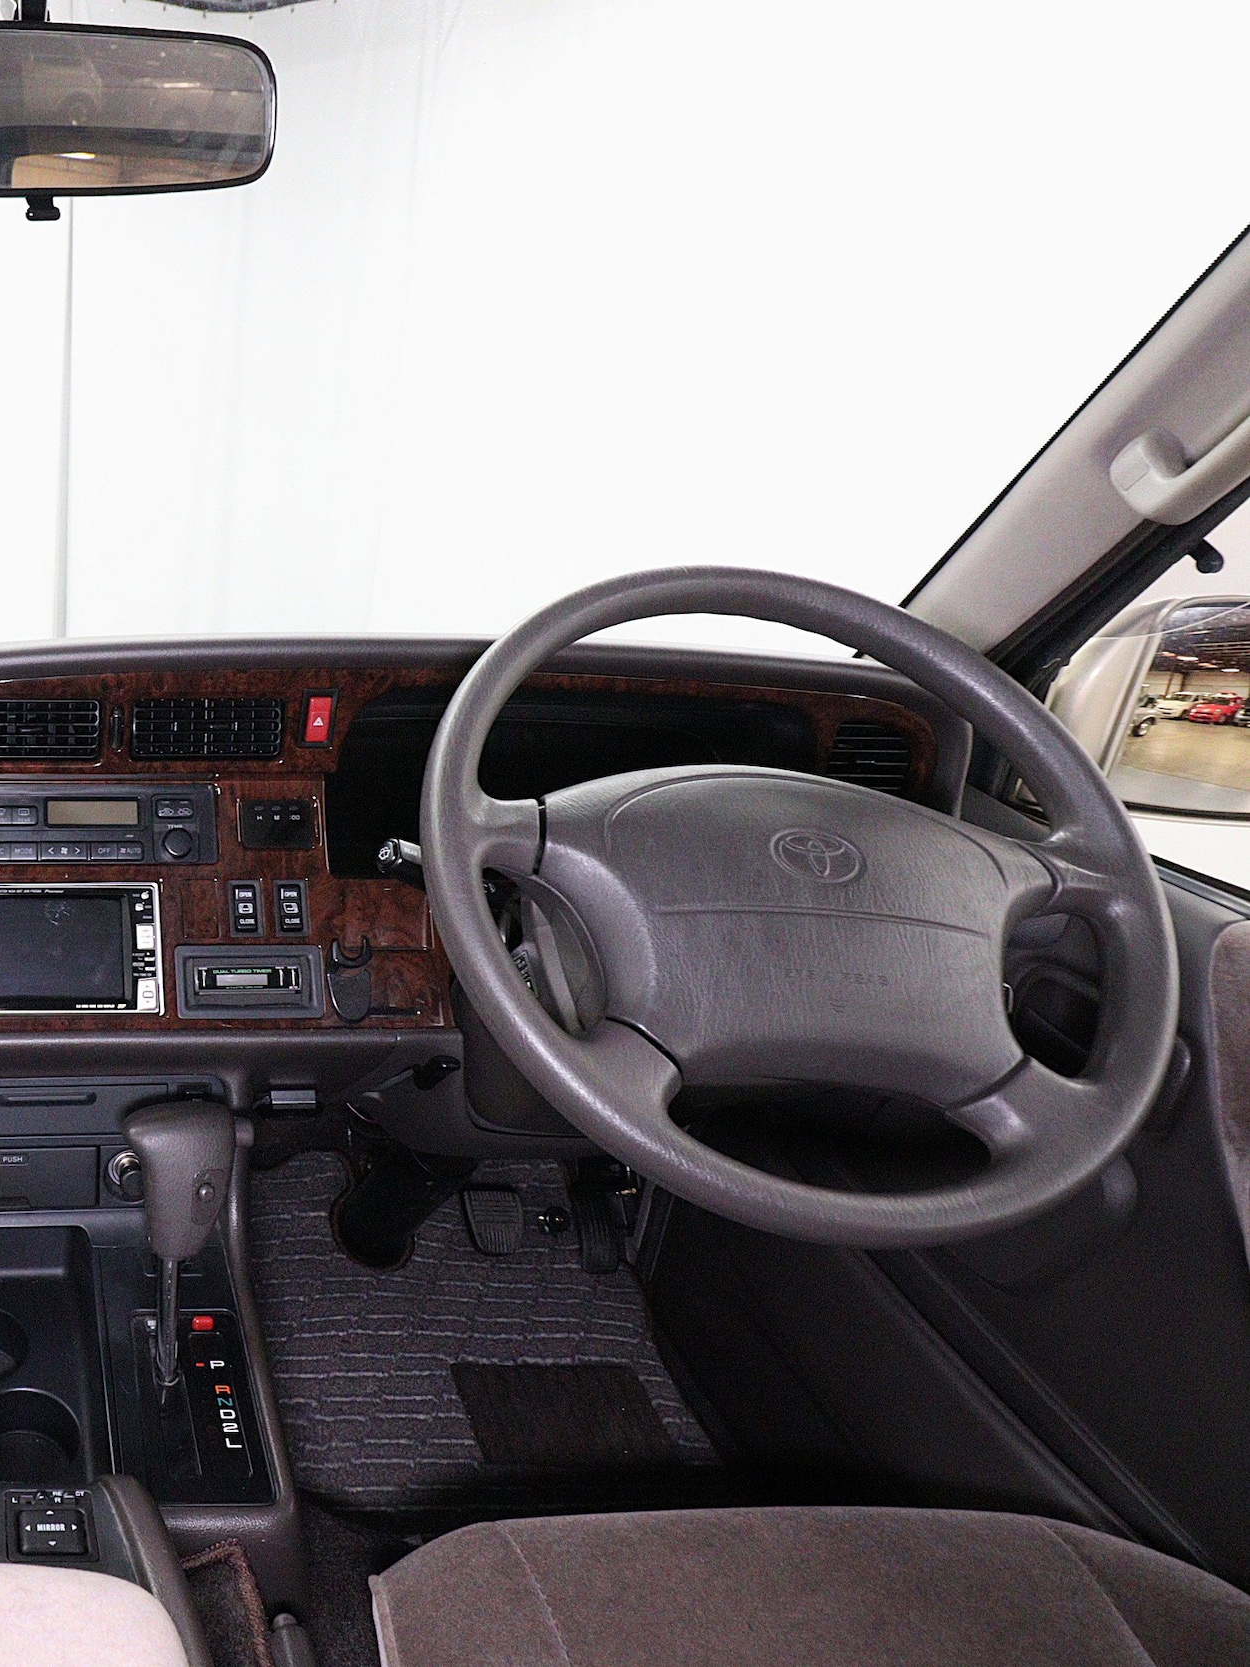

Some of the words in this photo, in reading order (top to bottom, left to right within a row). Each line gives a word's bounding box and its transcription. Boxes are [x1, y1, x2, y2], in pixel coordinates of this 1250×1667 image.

[209, 1360, 225, 1370] P
[214, 1385, 231, 1395] R
[217, 1397, 233, 1407] N
[219, 1409, 236, 1419] D
[222, 1422, 239, 1432] 2
[225, 1437, 243, 1448] L
[36, 1523, 66, 1532] MIRROR
